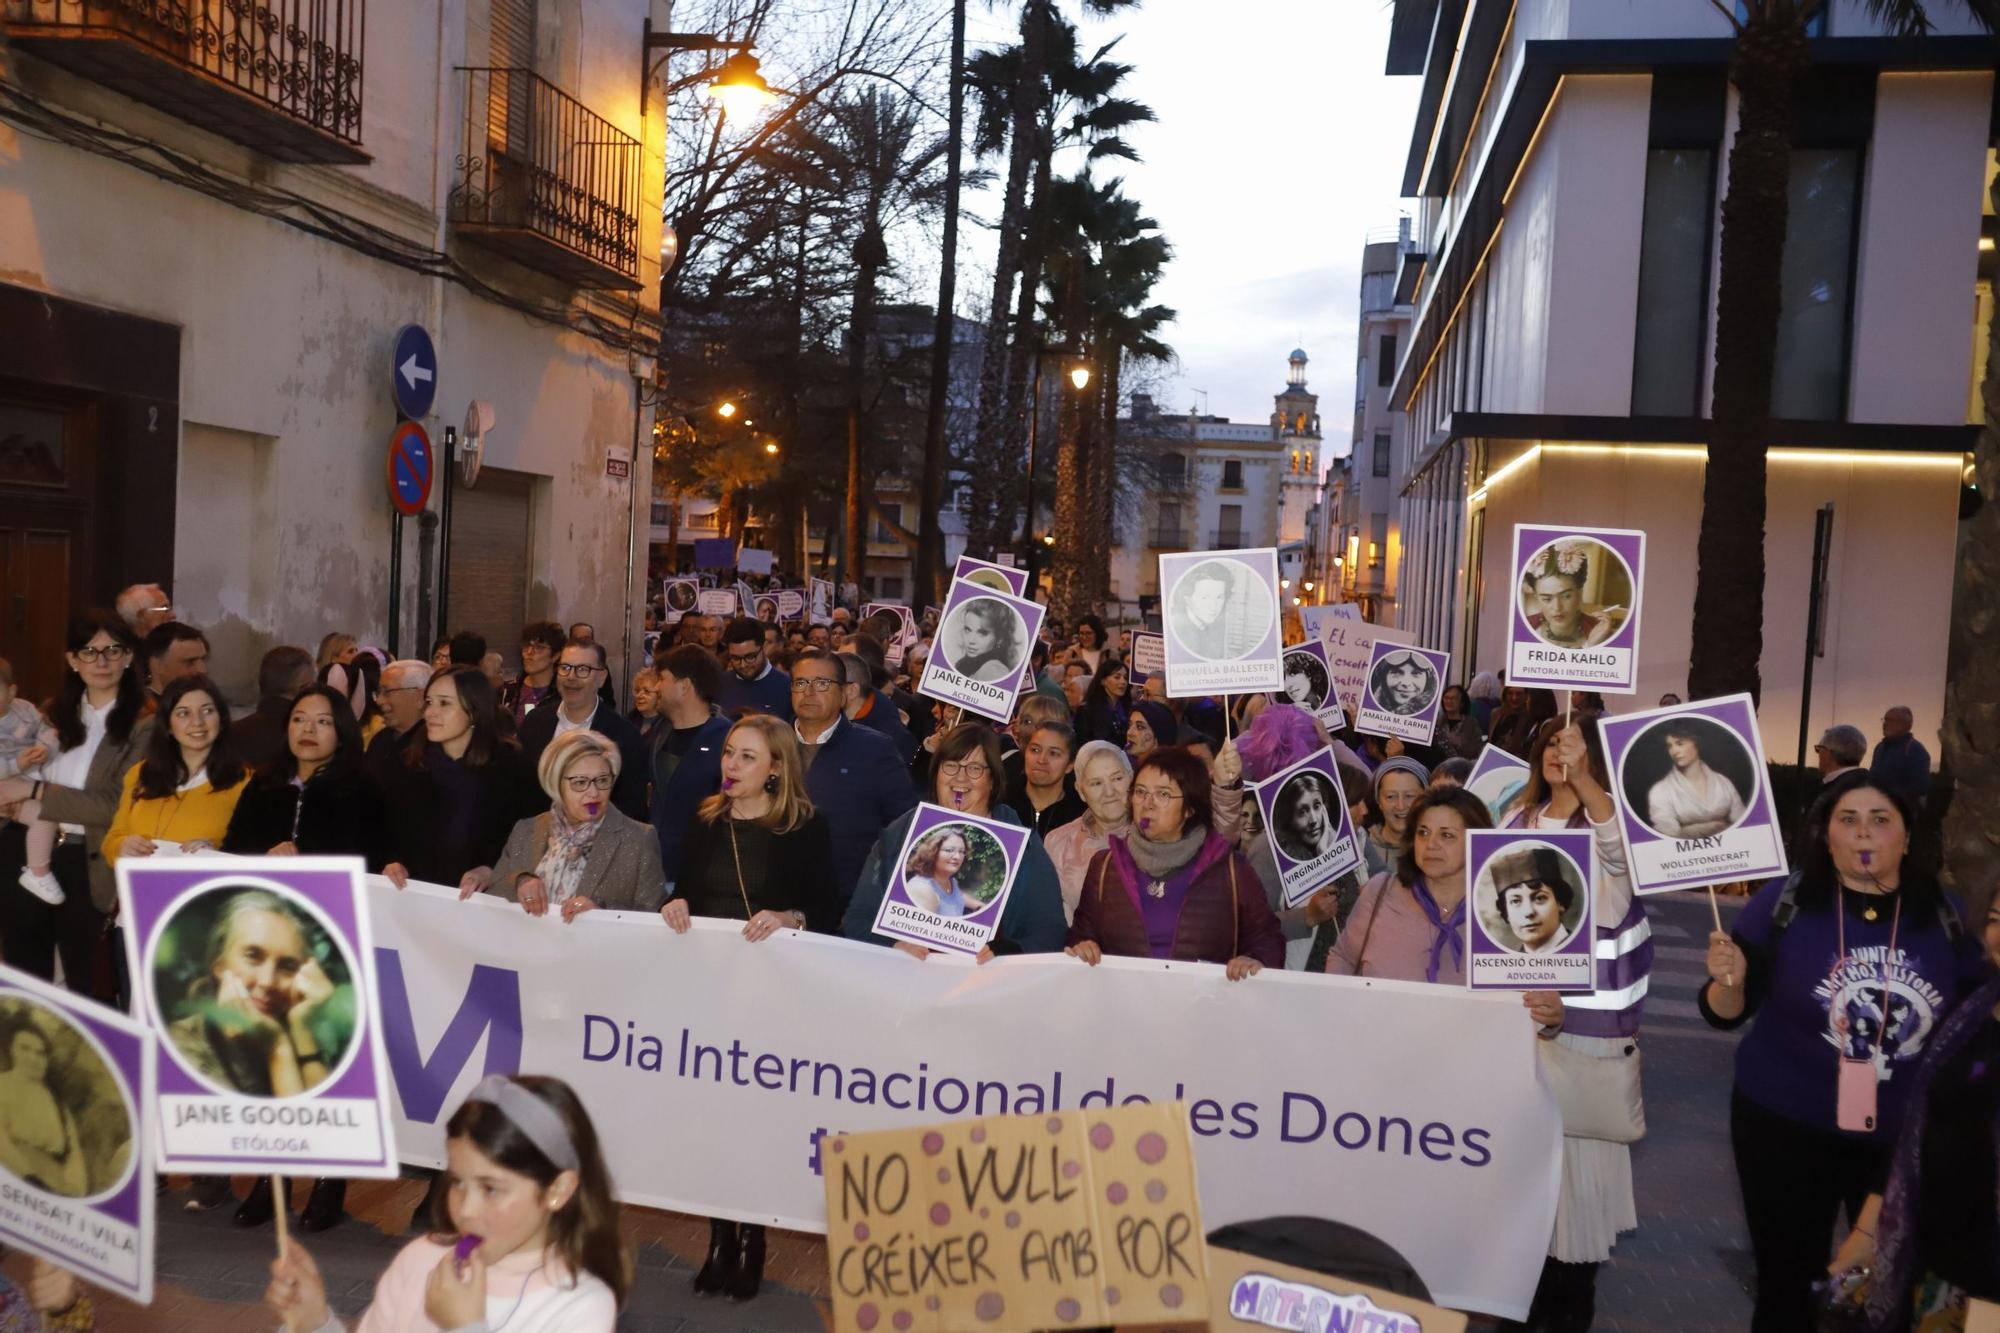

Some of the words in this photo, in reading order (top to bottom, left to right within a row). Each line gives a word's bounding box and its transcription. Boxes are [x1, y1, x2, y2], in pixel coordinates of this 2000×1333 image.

[148, 406, 158, 432] 2
[1528, 650, 1567, 663] FRIDA
[1571, 653, 1616, 666] KAHLO
[1172, 666, 1221, 678] MANUELA
[1223, 663, 1276, 674] BALLESTER
[1522, 666, 1559, 676] PINTORA
[1566, 669, 1620, 679] INTELECTUAL
[932, 669, 963, 686] JANE
[964, 679, 1004, 701] FONDA
[952, 690, 979, 705] ACTRIU
[1318, 709, 1338, 719] MOTTA
[1362, 711, 1391, 723] AMALIA
[1392, 717, 1402, 725] M.
[1403, 719, 1428, 730] EARHA
[1378, 724, 1409, 735] AVIADORA
[1675, 834, 1724, 853] MARY
[1285, 858, 1322, 885] VIRGINIA
[1322, 840, 1352, 863] WOOLF
[1660, 850, 1750, 871] WOLLSTONECRAFT
[1666, 870, 1701, 880] FILOSOFA
[1706, 862, 1750, 874] ESCRIPTORA
[890, 905, 942, 927] SOLEDAD
[944, 920, 985, 938] ARNAU
[890, 920, 929, 936] ACTIVISTA
[934, 931, 976, 949] SEXÓLOGA
[1474, 956, 1526, 968] ASCENSIÓ
[1528, 958, 1588, 967] CHIRIVELLA
[1850, 945, 1906, 966] JUNTAS
[1507, 972, 1556, 980] ADVOCADA
[1883, 964, 1944, 1008] HISTORIA
[583, 1014, 663, 1073] Dia
[679, 1028, 1061, 1116] Internacional
[1280, 1091, 1491, 1167] Dones
[175, 1104, 233, 1127] JANE
[241, 1105, 359, 1127] GOODALL
[231, 1136, 310, 1152] ETÓLOGA
[842, 1152, 909, 1222] NO
[957, 1143, 1078, 1212] VULL
[2, 1183, 74, 1226] SENSAT
[79, 1217, 85, 1231] I
[93, 1221, 136, 1255] VILA
[35, 1221, 109, 1262] PEDAGOGA
[1020, 1228, 1098, 1285] AMB
[1116, 1212, 1196, 1281] POR
